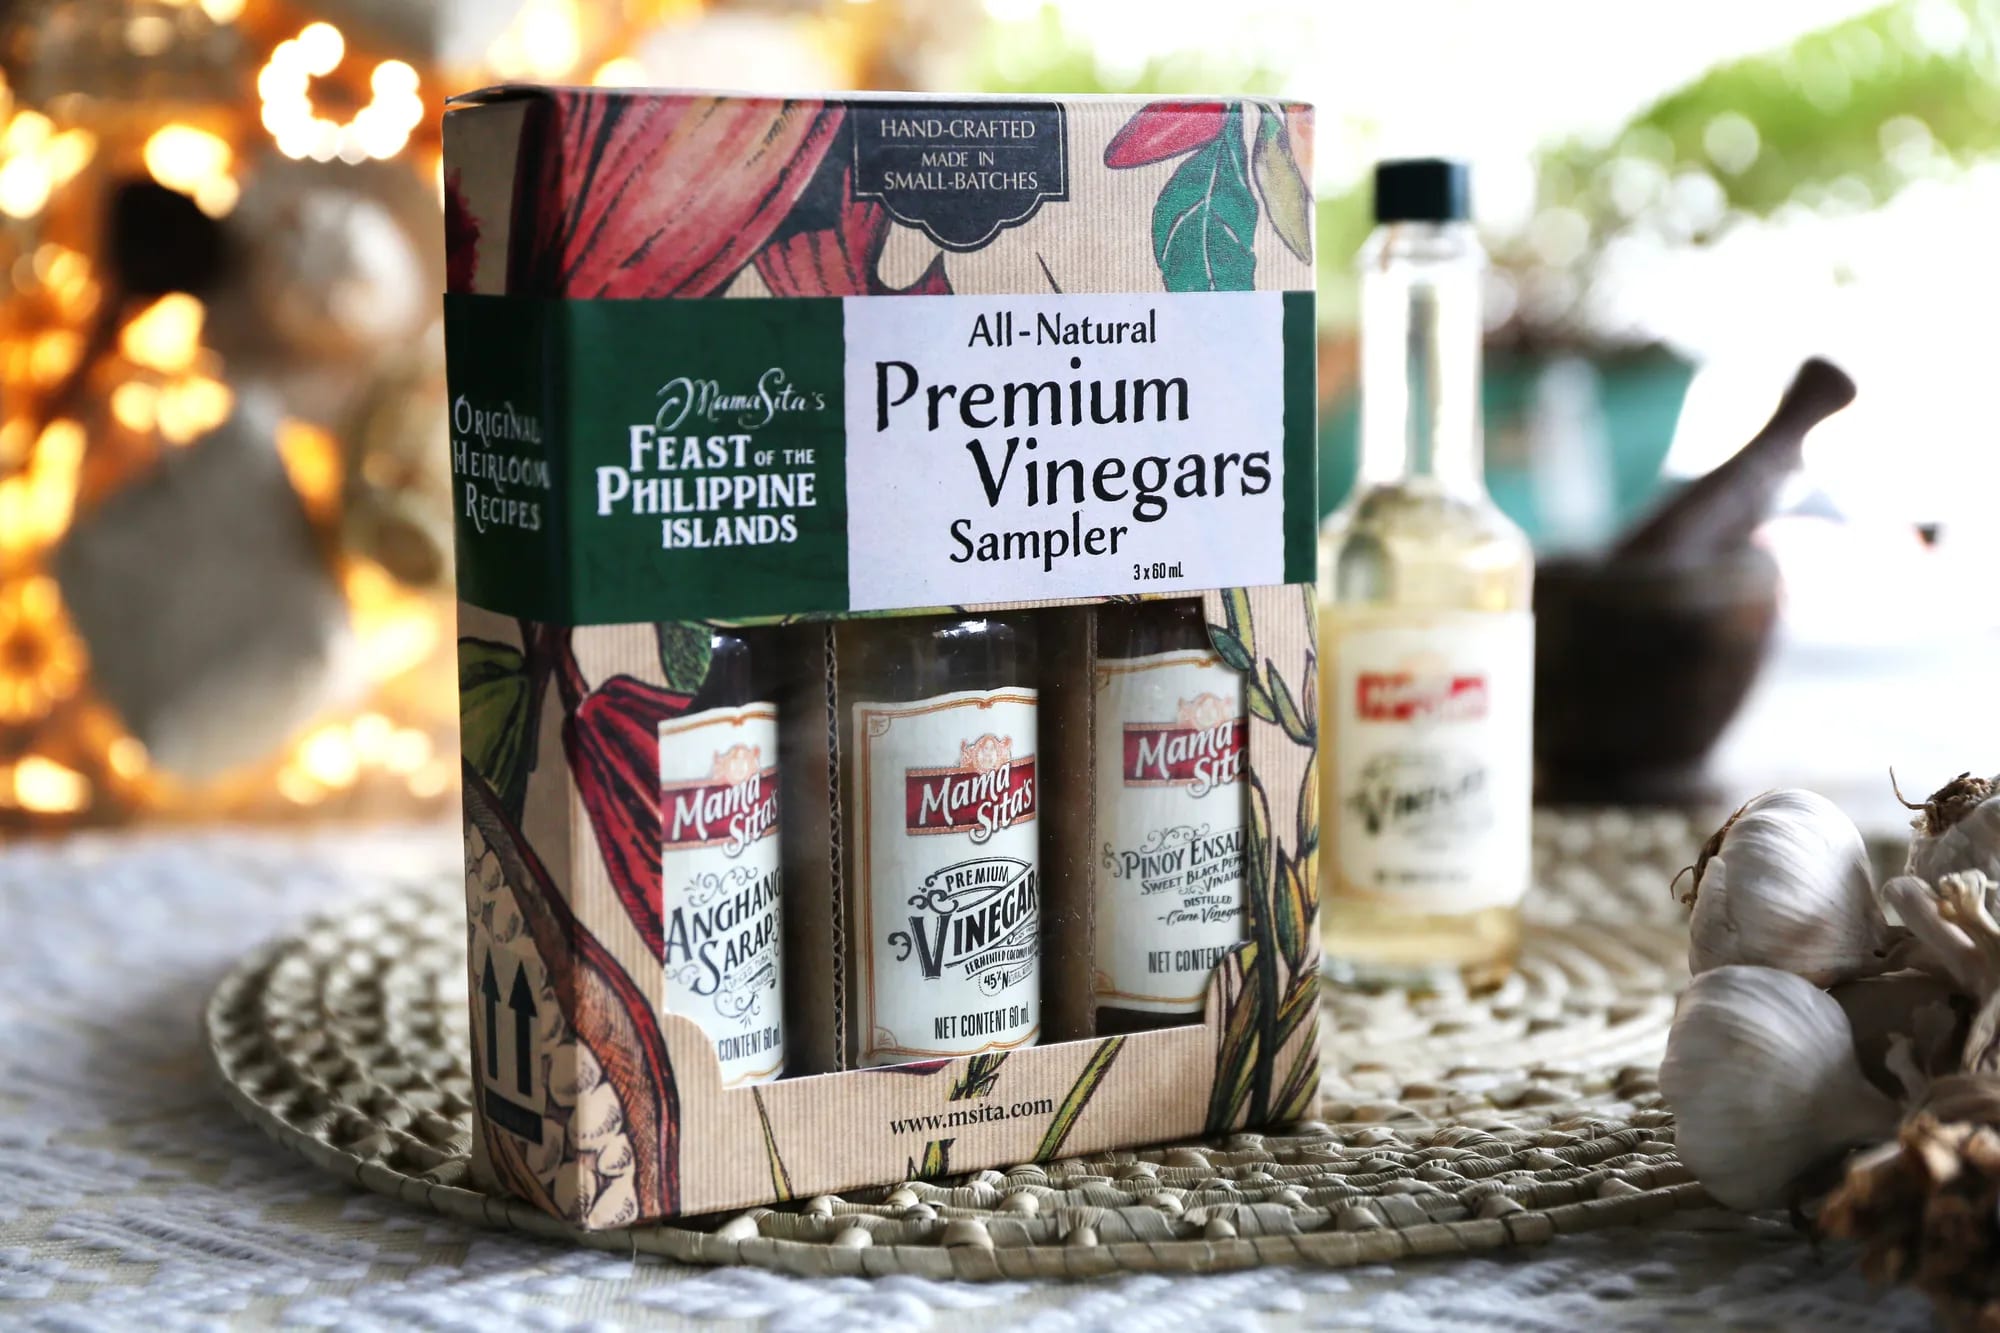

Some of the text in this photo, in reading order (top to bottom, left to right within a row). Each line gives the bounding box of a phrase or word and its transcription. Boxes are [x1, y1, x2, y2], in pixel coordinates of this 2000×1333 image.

[880, 118, 1036, 138] HAND-CRAFTED
[884, 171, 1038, 190] SMALL-BATCHES
[921, 151, 994, 167] MADE IN
[968, 308, 1157, 347] All-Natural
[875, 356, 1190, 432] Premium
[454, 394, 542, 448] ORIGINAL
[453, 439, 550, 495] HEIRLOOM
[629, 424, 816, 472] FEAST OF THE
[595, 465, 817, 516] PHILIPPINE
[966, 436, 1272, 523] Vinegars
[465, 482, 541, 534] RECIPES
[661, 514, 799, 550] ISLANDS
[949, 511, 1128, 572] Sampler
[1133, 561, 1184, 580] 3 x 60 mL
[1135, 720, 1233, 780] Mama
[672, 772, 760, 842] Mama
[919, 761, 1011, 827] Mama
[968, 777, 1033, 844] Sita's
[721, 786, 778, 859] Sita's
[945, 865, 1009, 892] PREMIUM
[1121, 848, 1185, 880] PINOY
[1140, 875, 1184, 896] SWEET
[1186, 863, 1219, 886] BLACK
[664, 866, 782, 965] ANGHANG
[908, 869, 1038, 980] VINEGAR
[1183, 895, 1232, 909] DISTILLED
[689, 912, 774, 996] SARAP
[964, 949, 1006, 976] FERMENTED
[1148, 950, 1171, 974] NET
[718, 1029, 761, 1062] CONTENT
[935, 1016, 957, 1040] NET
[960, 1008, 1006, 1037] CONTENT
[1009, 1005, 1019, 1029] 60
[889, 1098, 1053, 1136] www.msita.com
